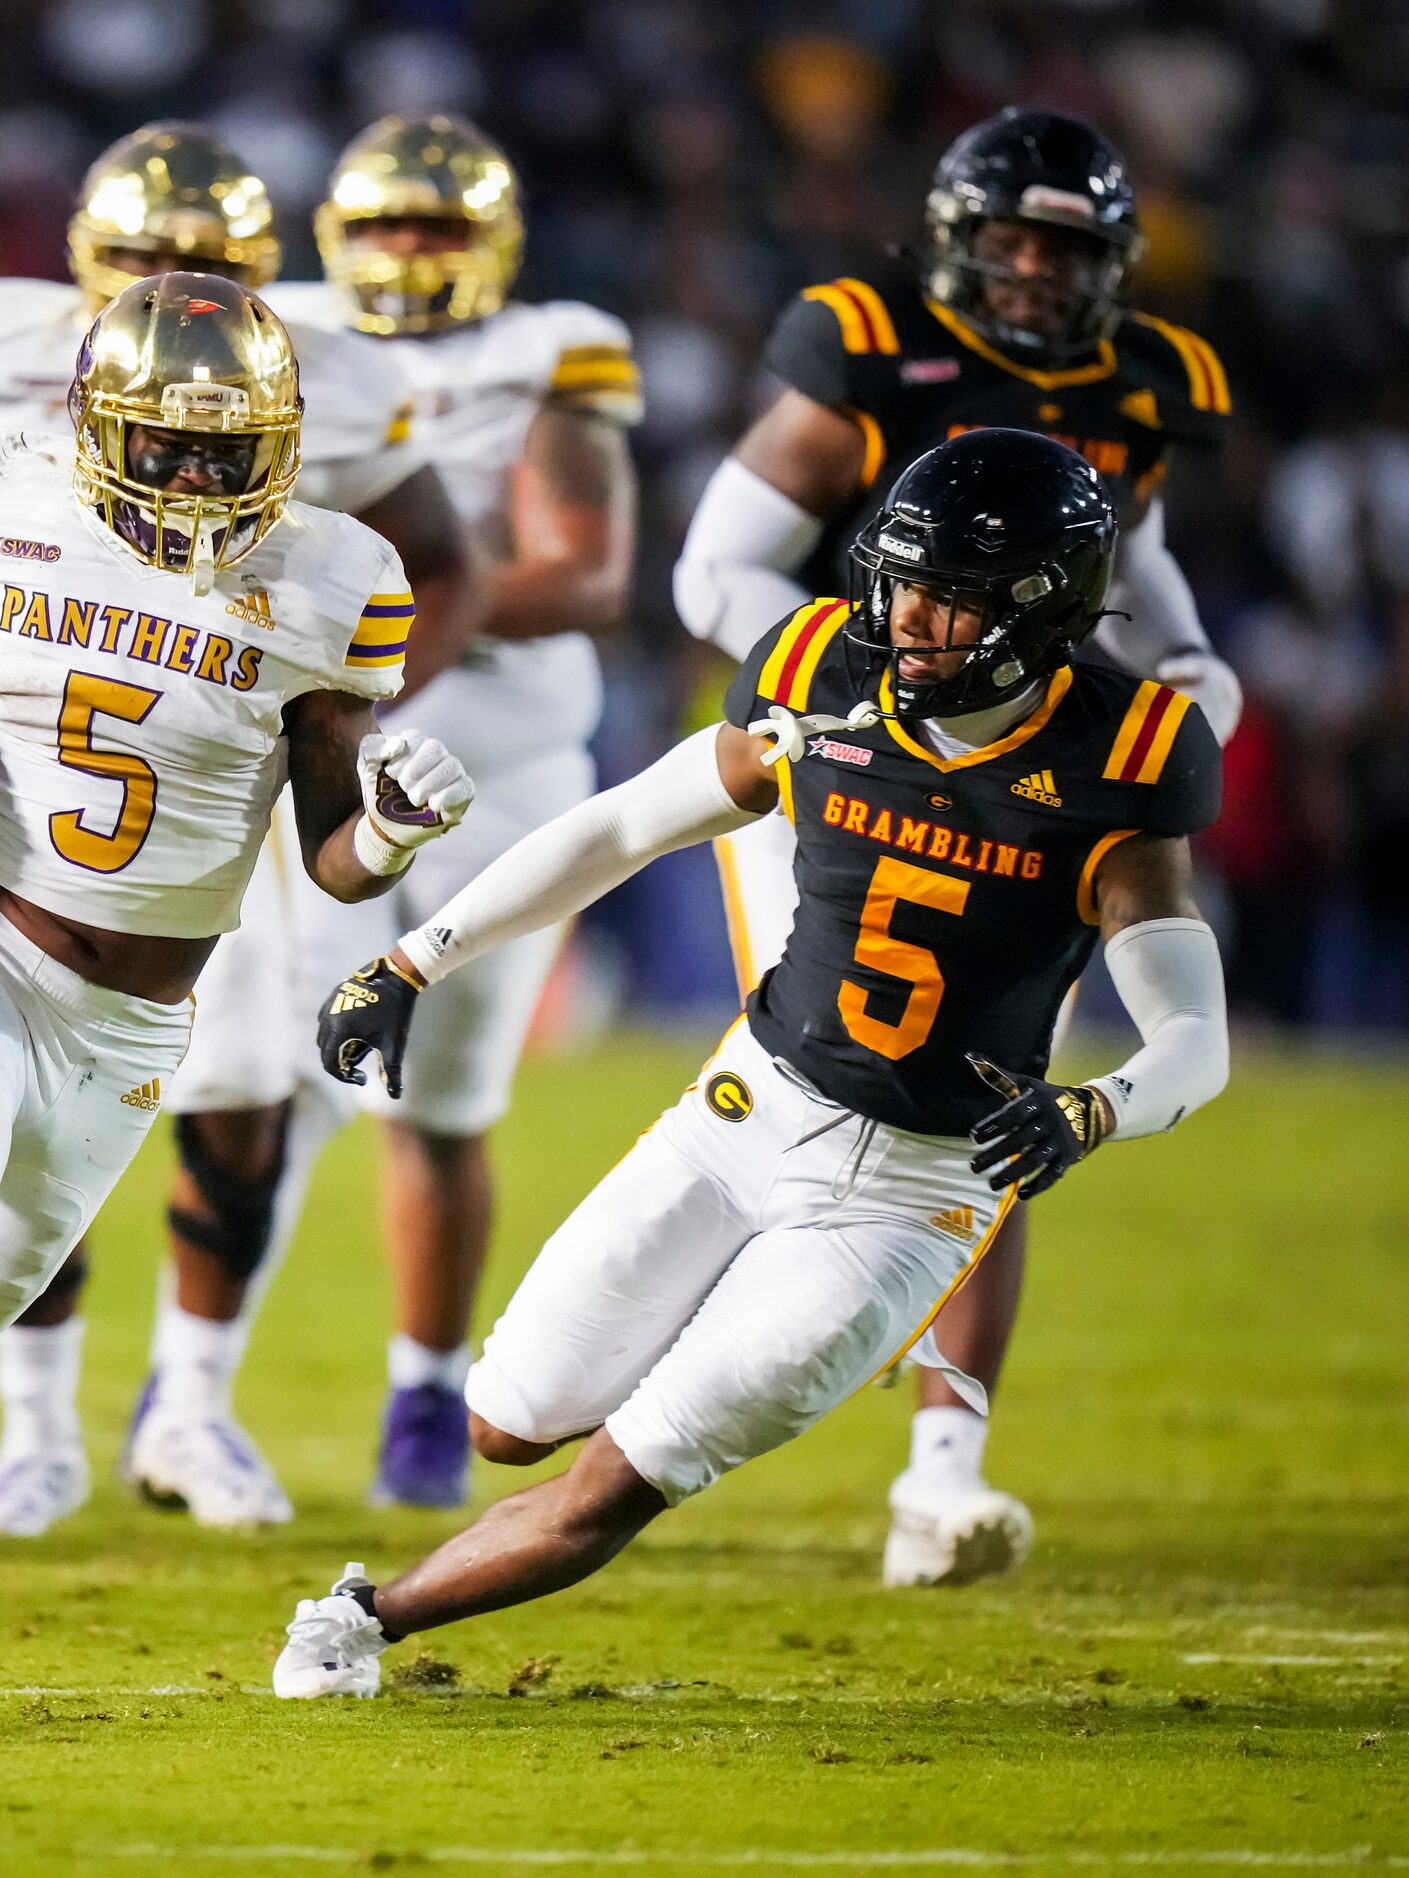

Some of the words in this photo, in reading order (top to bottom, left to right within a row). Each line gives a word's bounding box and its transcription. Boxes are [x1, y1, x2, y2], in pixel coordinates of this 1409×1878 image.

[1, 537, 62, 563] SWAC
[225, 604, 276, 631] adidas
[826, 742, 872, 766] SWAC
[49, 669, 164, 874] 5
[1010, 784, 1062, 808] adidas
[823, 791, 1045, 881] GRAMBLING
[837, 855, 972, 1061] 5
